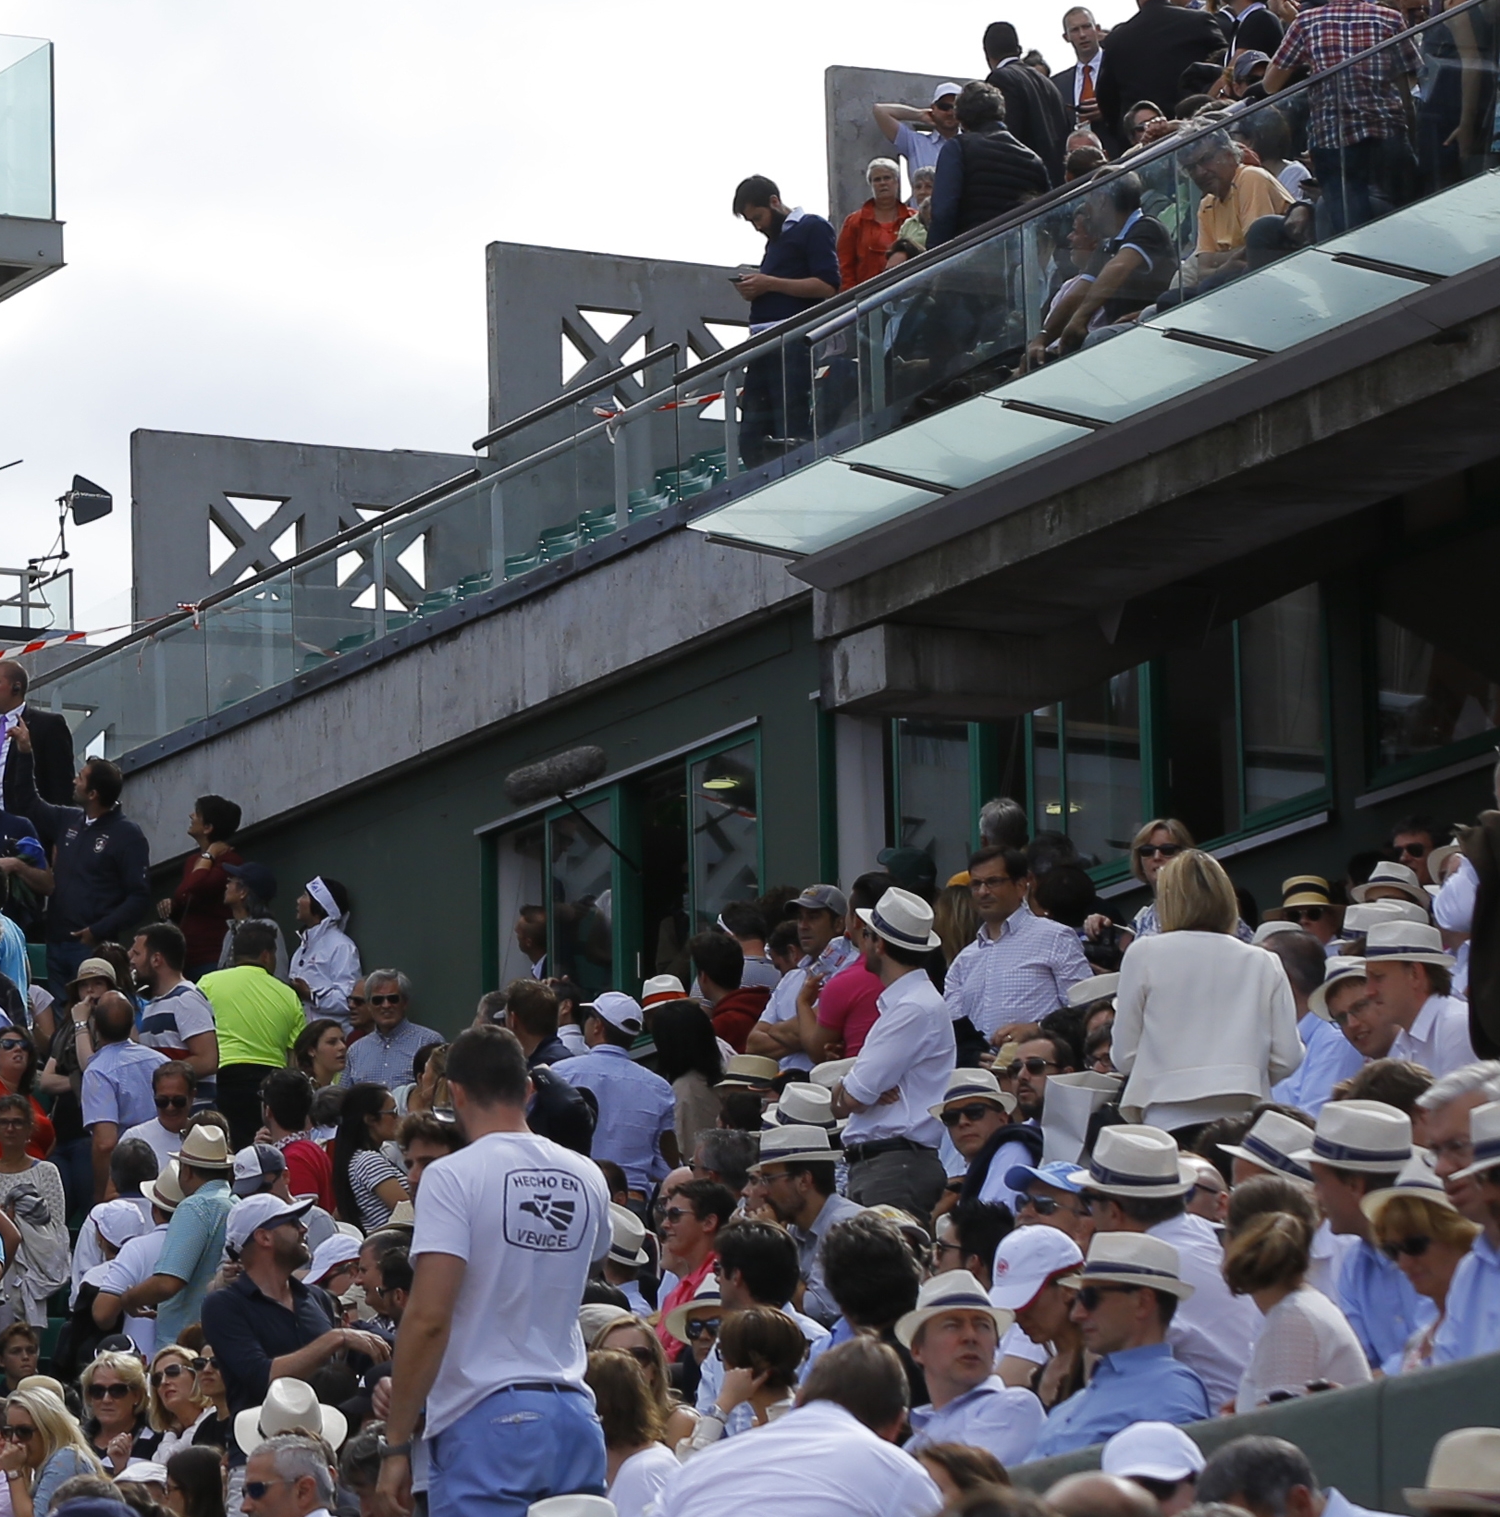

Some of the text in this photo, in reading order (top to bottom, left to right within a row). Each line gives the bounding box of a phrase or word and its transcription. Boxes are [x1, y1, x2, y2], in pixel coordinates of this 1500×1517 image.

[512, 1175, 578, 1192] HECHO EN
[517, 1228, 568, 1247] VENICE
